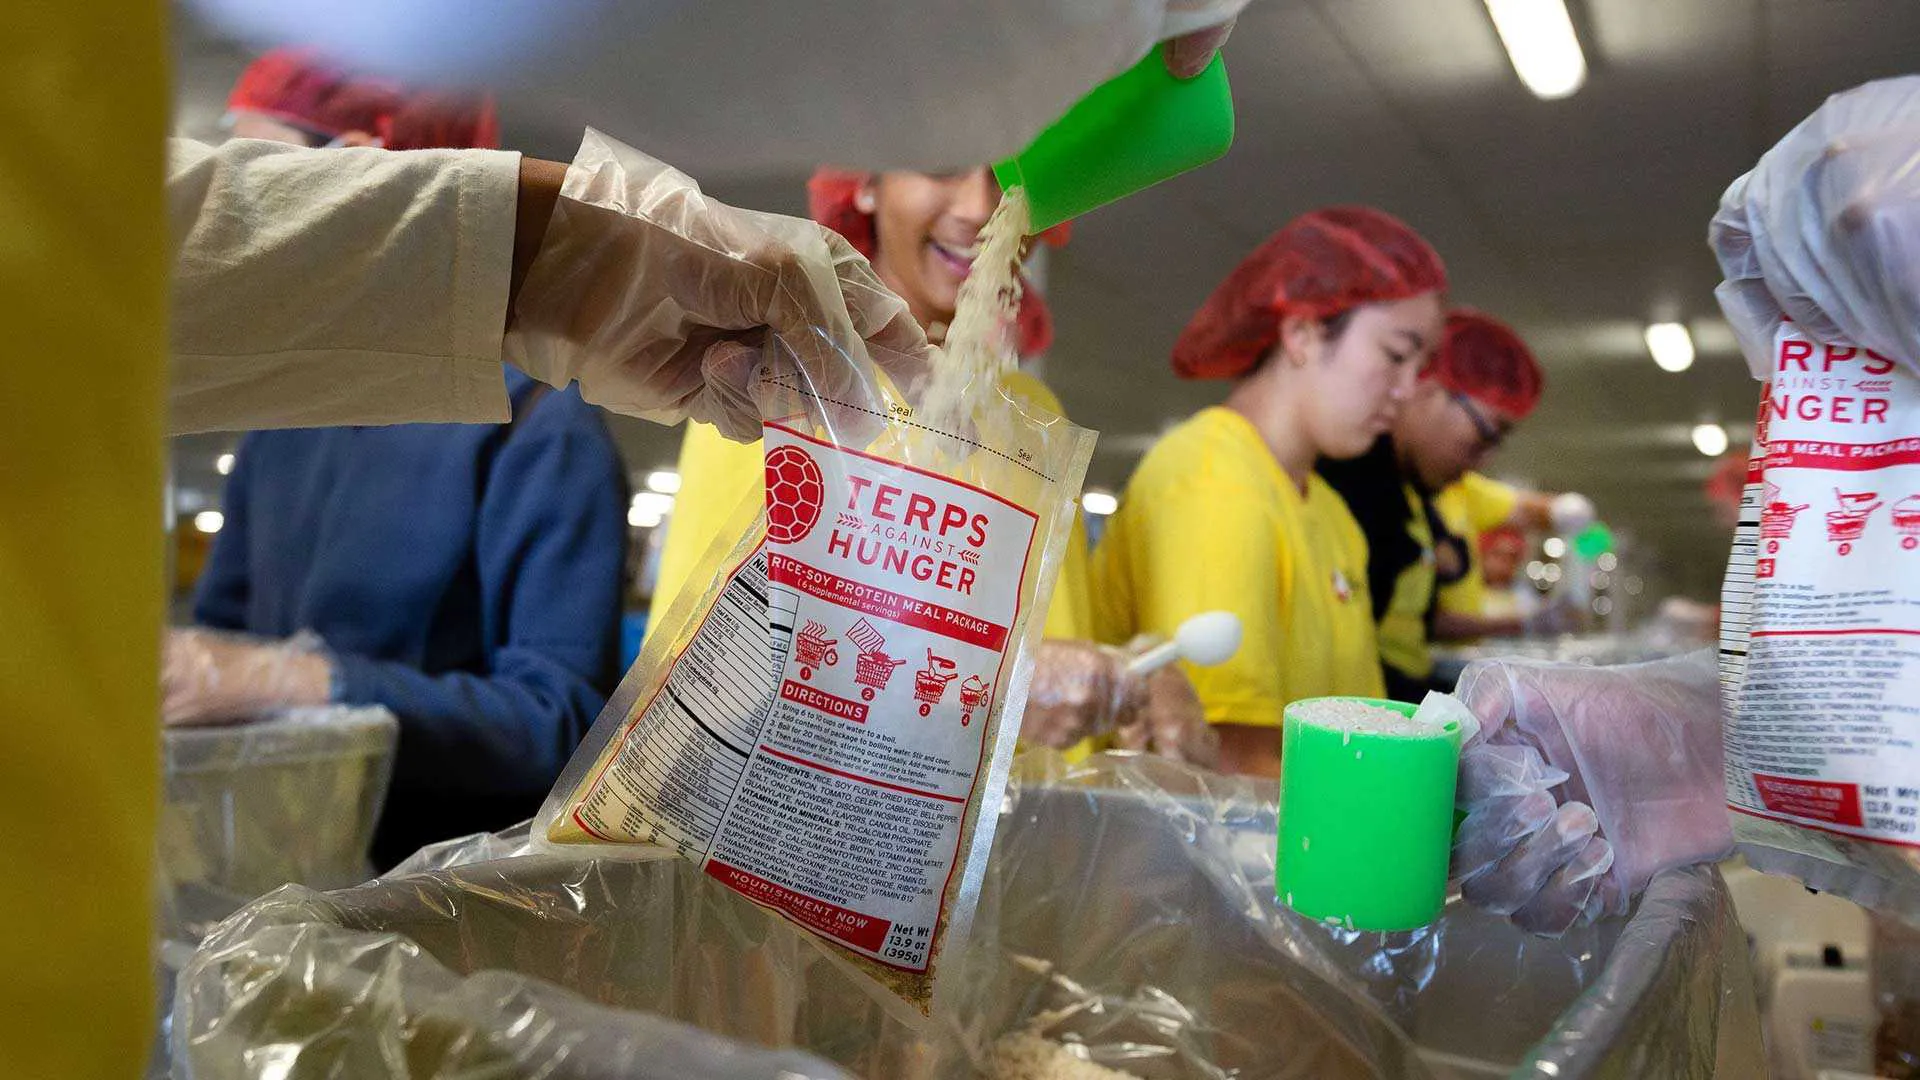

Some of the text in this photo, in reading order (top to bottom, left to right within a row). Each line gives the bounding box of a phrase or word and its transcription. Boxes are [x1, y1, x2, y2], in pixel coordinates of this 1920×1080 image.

[889, 403, 914, 418] Seal
[1017, 448, 1034, 463] Seal
[846, 475, 991, 549] TERPS
[870, 522, 956, 556] AGAINST
[827, 529, 977, 595] HUNGER
[771, 556, 832, 586] RICE-SOY
[835, 580, 899, 607] PROTEIN
[902, 599, 941, 620] MEAL
[945, 612, 990, 634] PACKAGE
[807, 583, 861, 607] supplemental
[861, 600, 901, 619] servings)
[785, 684, 863, 718] DIRECTIONS
[802, 729, 813, 738] 20
[830, 729, 858, 744] package
[859, 737, 868, 745] to
[755, 753, 813, 779] INGREDIENTS:
[834, 780, 852, 790] SOY
[880, 791, 903, 802] DRIED
[741, 786, 779, 807] VITAMINS
[779, 801, 798, 814] AND
[769, 778, 797, 794] ONION
[836, 800, 873, 815] DISODIUM
[920, 810, 937, 818] BELL
[737, 794, 787, 819] MAGNESIUM
[835, 830, 874, 845] ASCORBIC
[895, 844, 923, 855] VITAMIN
[795, 798, 831, 815] NATURAL
[868, 819, 898, 831] CANOLA
[726, 819, 777, 844] MANGANESE
[806, 849, 840, 865] COPPER
[888, 872, 918, 883] VITAMIN
[772, 818, 803, 835] FERRIC
[877, 850, 906, 862] VITAMIN
[785, 832, 822, 850] CALCIUM
[884, 861, 902, 871] ZINC
[712, 851, 847, 905] CONTAINS SOYBEAN INGREDIENTS
[719, 834, 752, 853] THIAMIN
[825, 874, 849, 887] FOLIC
[870, 886, 901, 899] VITAMIN
[792, 872, 838, 892] POTASSIUM
[729, 870, 832, 916] NOURISHMENT
[836, 911, 868, 929] NOW
[887, 935, 925, 950] 13.9 oz
[893, 923, 929, 937] Net Wt
[883, 948, 922, 964] (395g)
